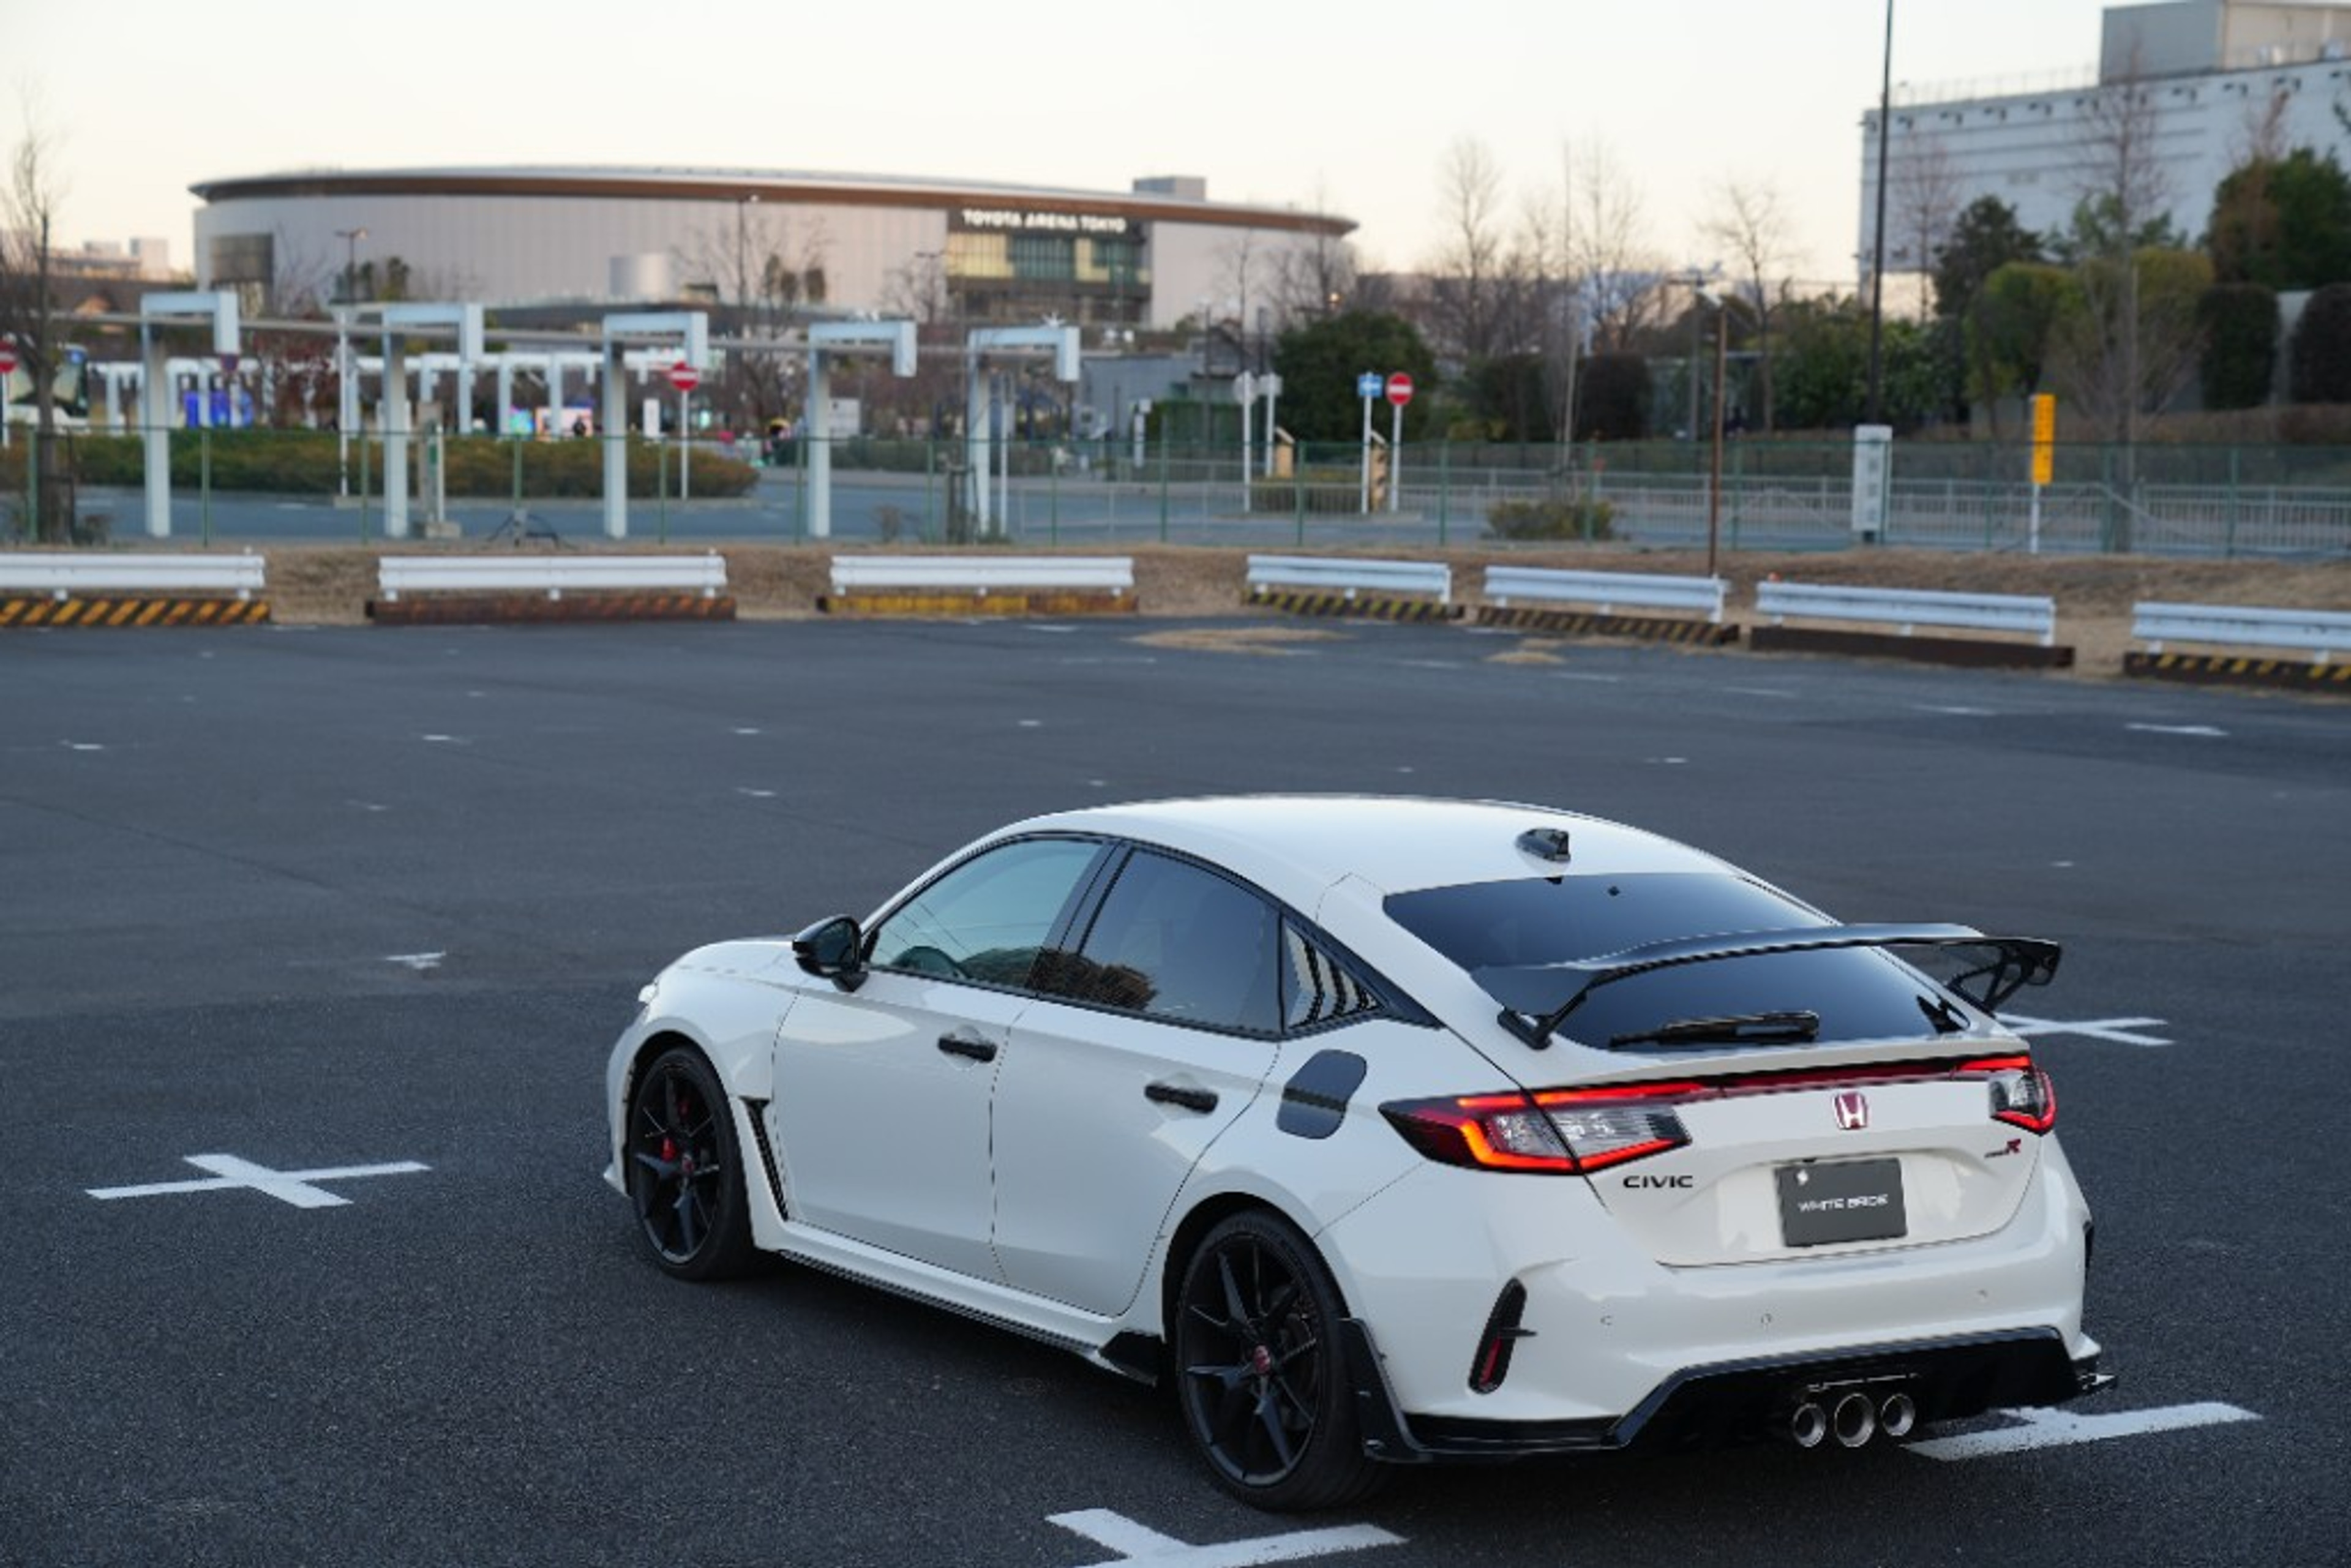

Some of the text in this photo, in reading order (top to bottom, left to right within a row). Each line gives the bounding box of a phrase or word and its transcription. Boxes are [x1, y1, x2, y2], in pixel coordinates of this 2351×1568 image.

[962, 209, 1127, 233] TOYOTA ARENA TOKYO
[1623, 1175, 1693, 1188] CIVIC
[1798, 1198, 1844, 1212] WHITE
